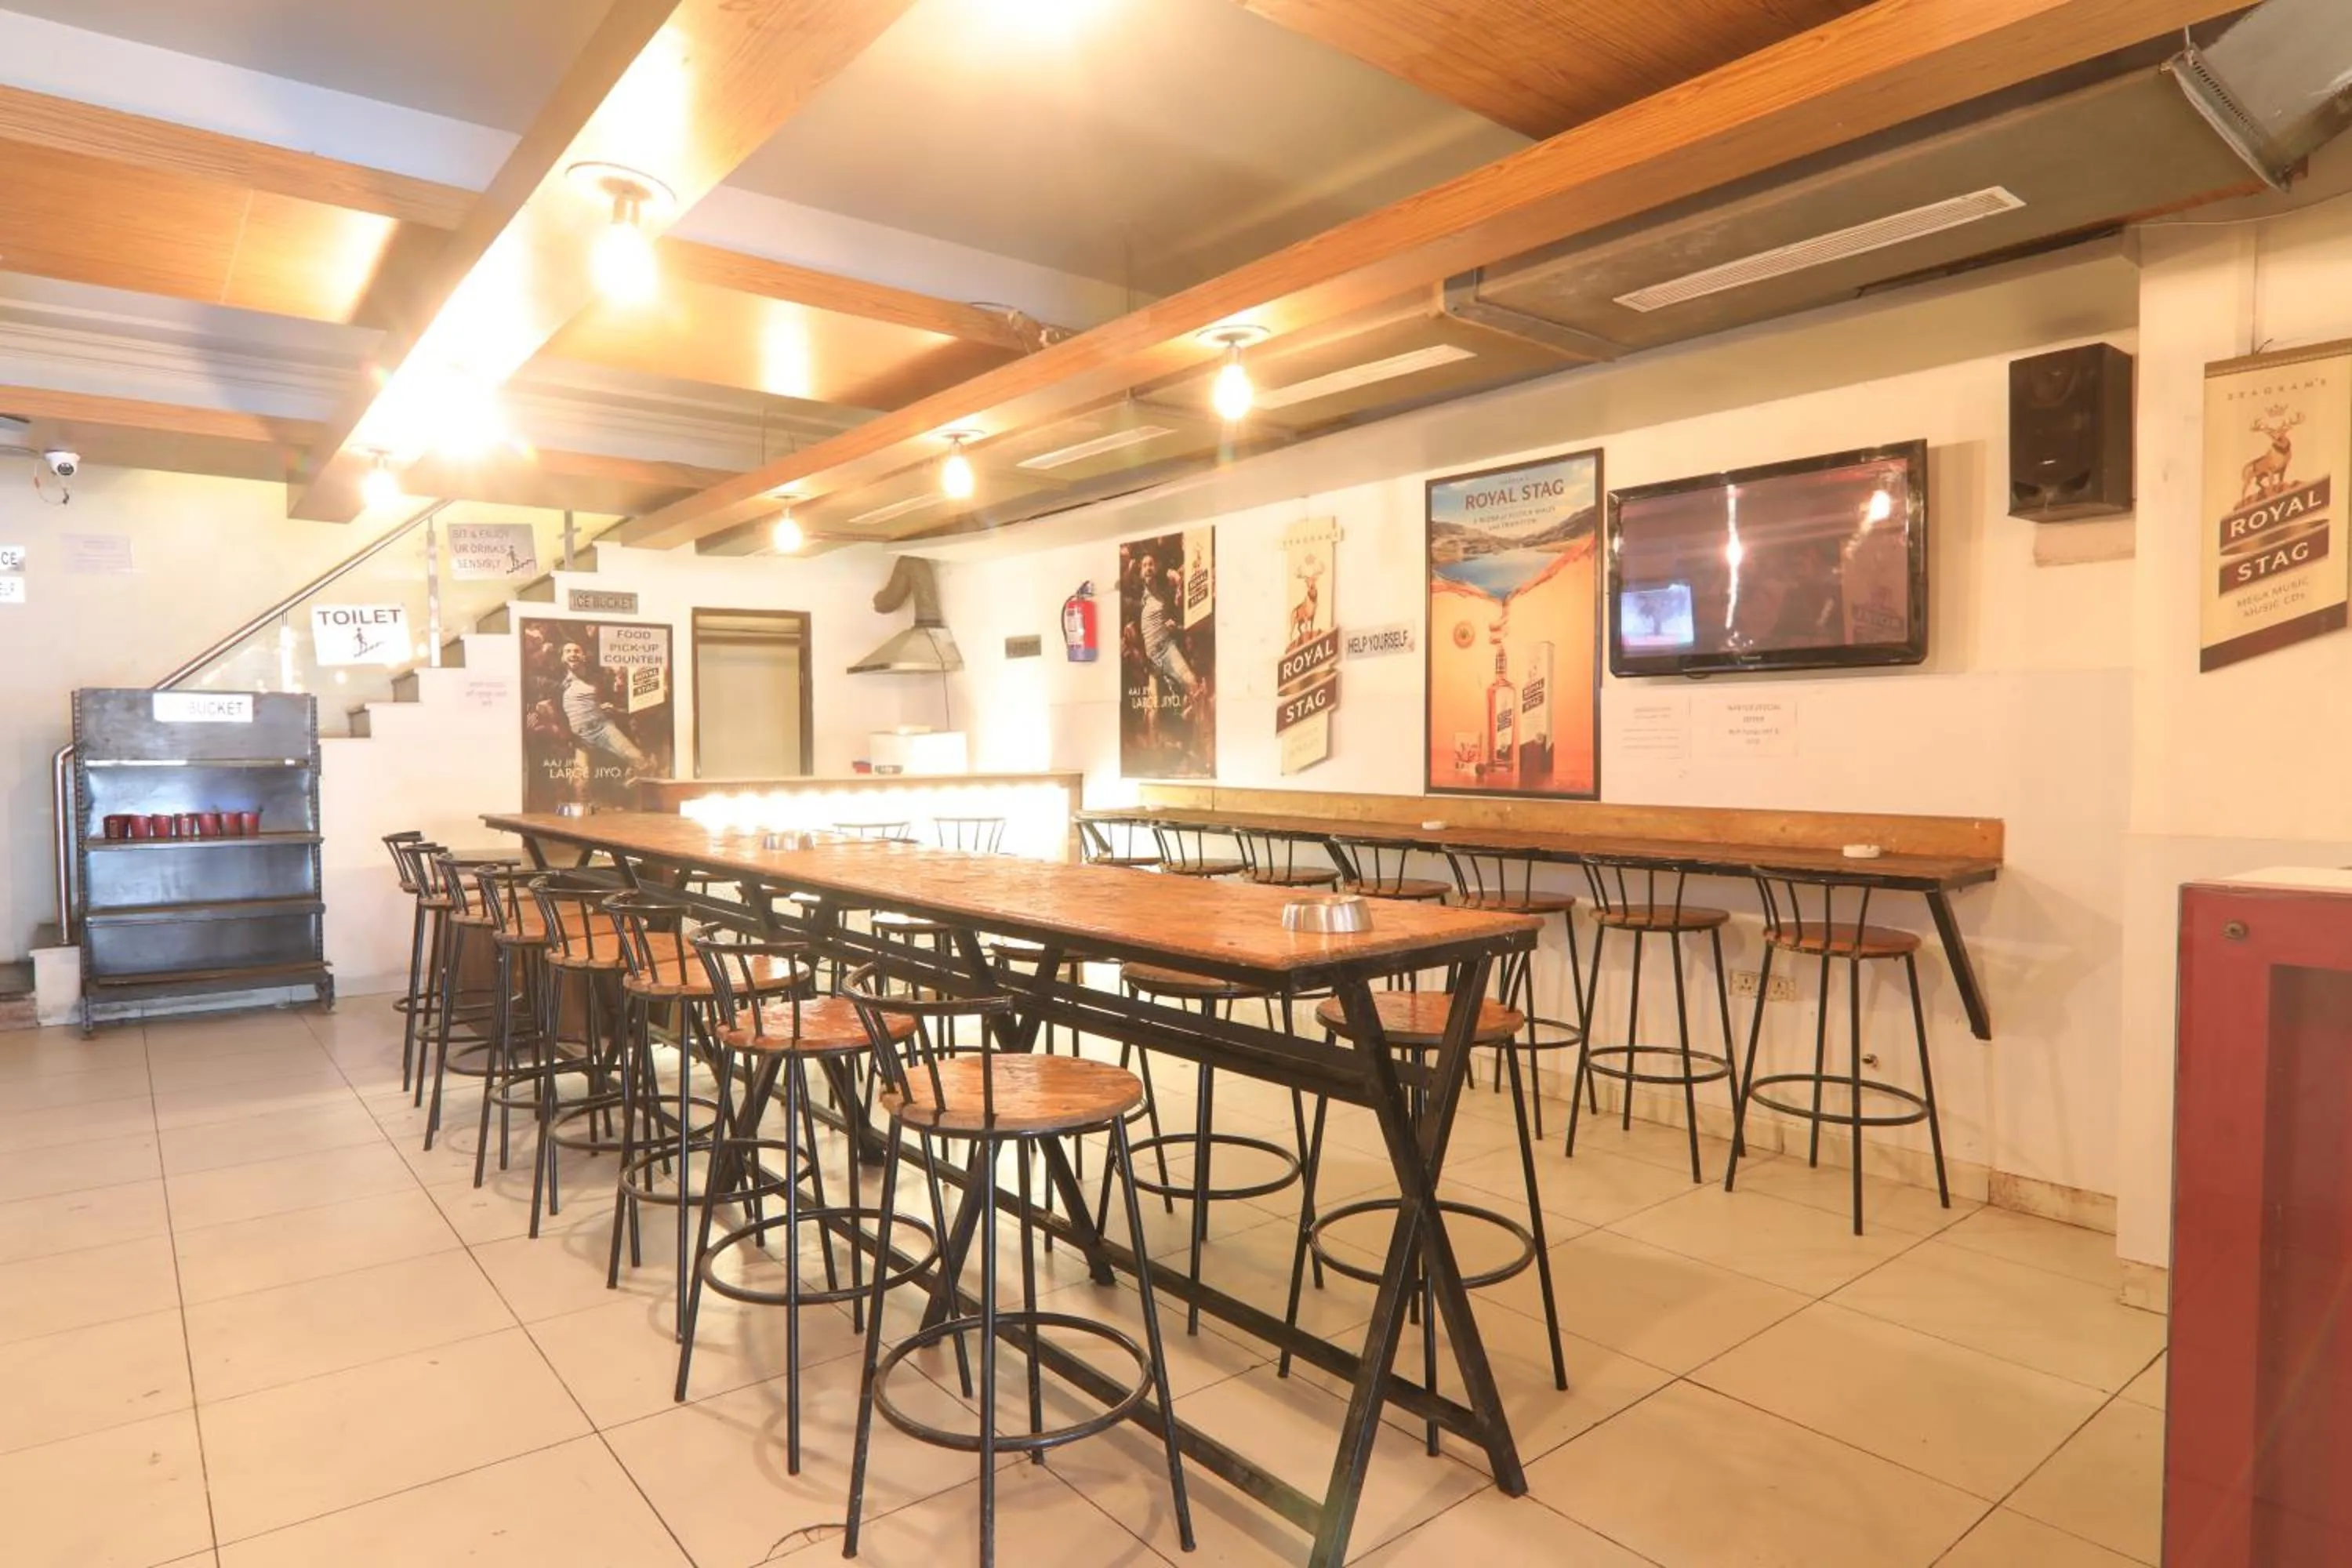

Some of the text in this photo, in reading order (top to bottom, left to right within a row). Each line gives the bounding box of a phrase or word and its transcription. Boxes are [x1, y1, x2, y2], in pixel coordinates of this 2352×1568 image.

[1465, 478, 1565, 510] ROYAL STAG
[2230, 490, 2322, 539] ROYAL
[2237, 542, 2309, 582] STAG
[2271, 576, 2310, 599] MUSIC
[573, 595, 633, 610] ICE BUCKET
[317, 609, 401, 626] TOILET
[616, 630, 652, 639] FOOD
[1347, 630, 1409, 654] HELP YOURSELF
[604, 655, 662, 664] COUNTER
[609, 643, 659, 653] PICK-UP
[1283, 639, 1334, 681] ROYAL
[187, 700, 244, 716] BUCKET
[1286, 688, 1327, 723] STAG
